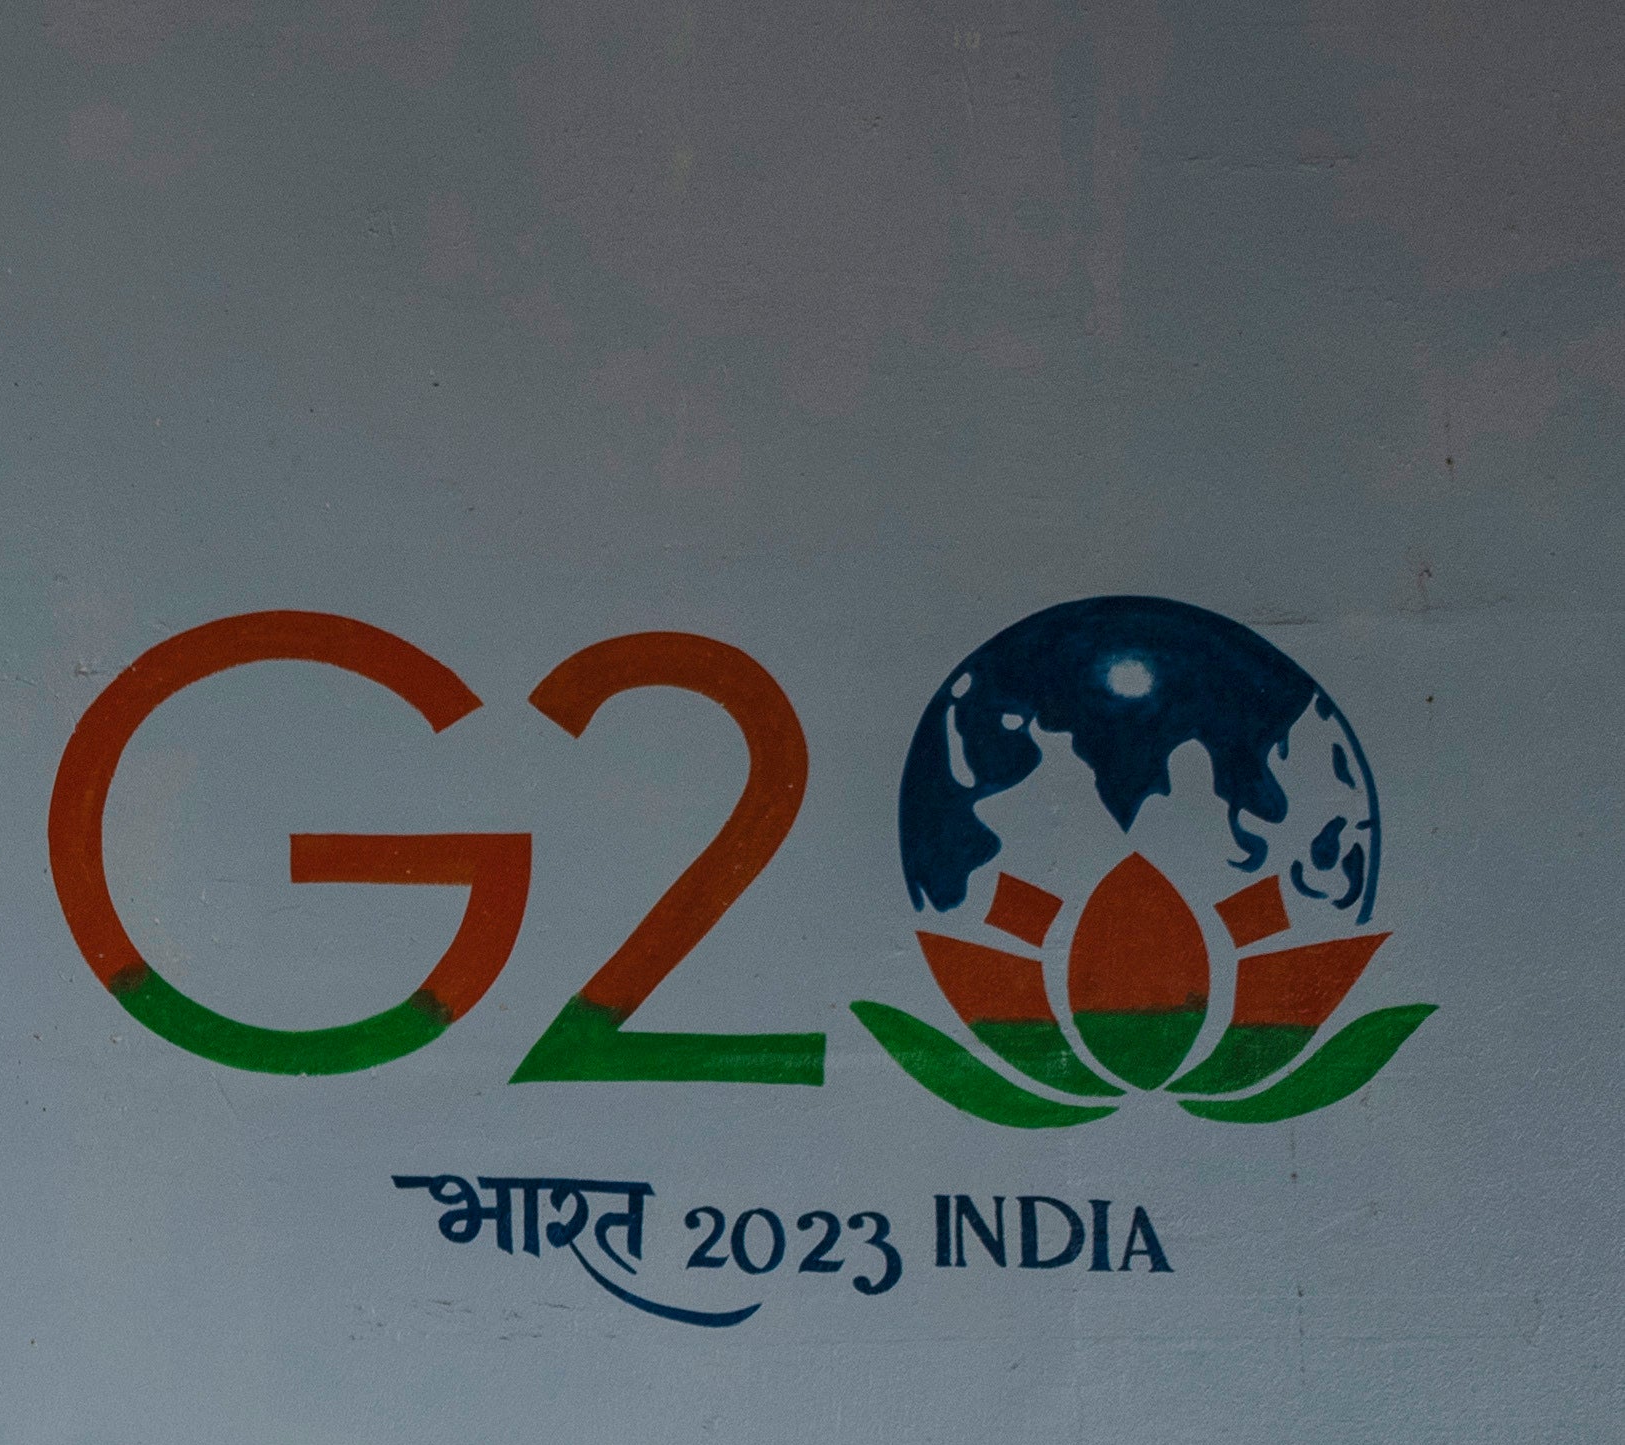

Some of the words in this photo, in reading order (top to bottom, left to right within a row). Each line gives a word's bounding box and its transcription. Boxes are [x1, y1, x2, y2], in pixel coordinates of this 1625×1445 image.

[391, 1174, 762, 1327] भारत
[683, 1205, 904, 1296] 2023
[932, 1193, 1175, 1273] INDIA
